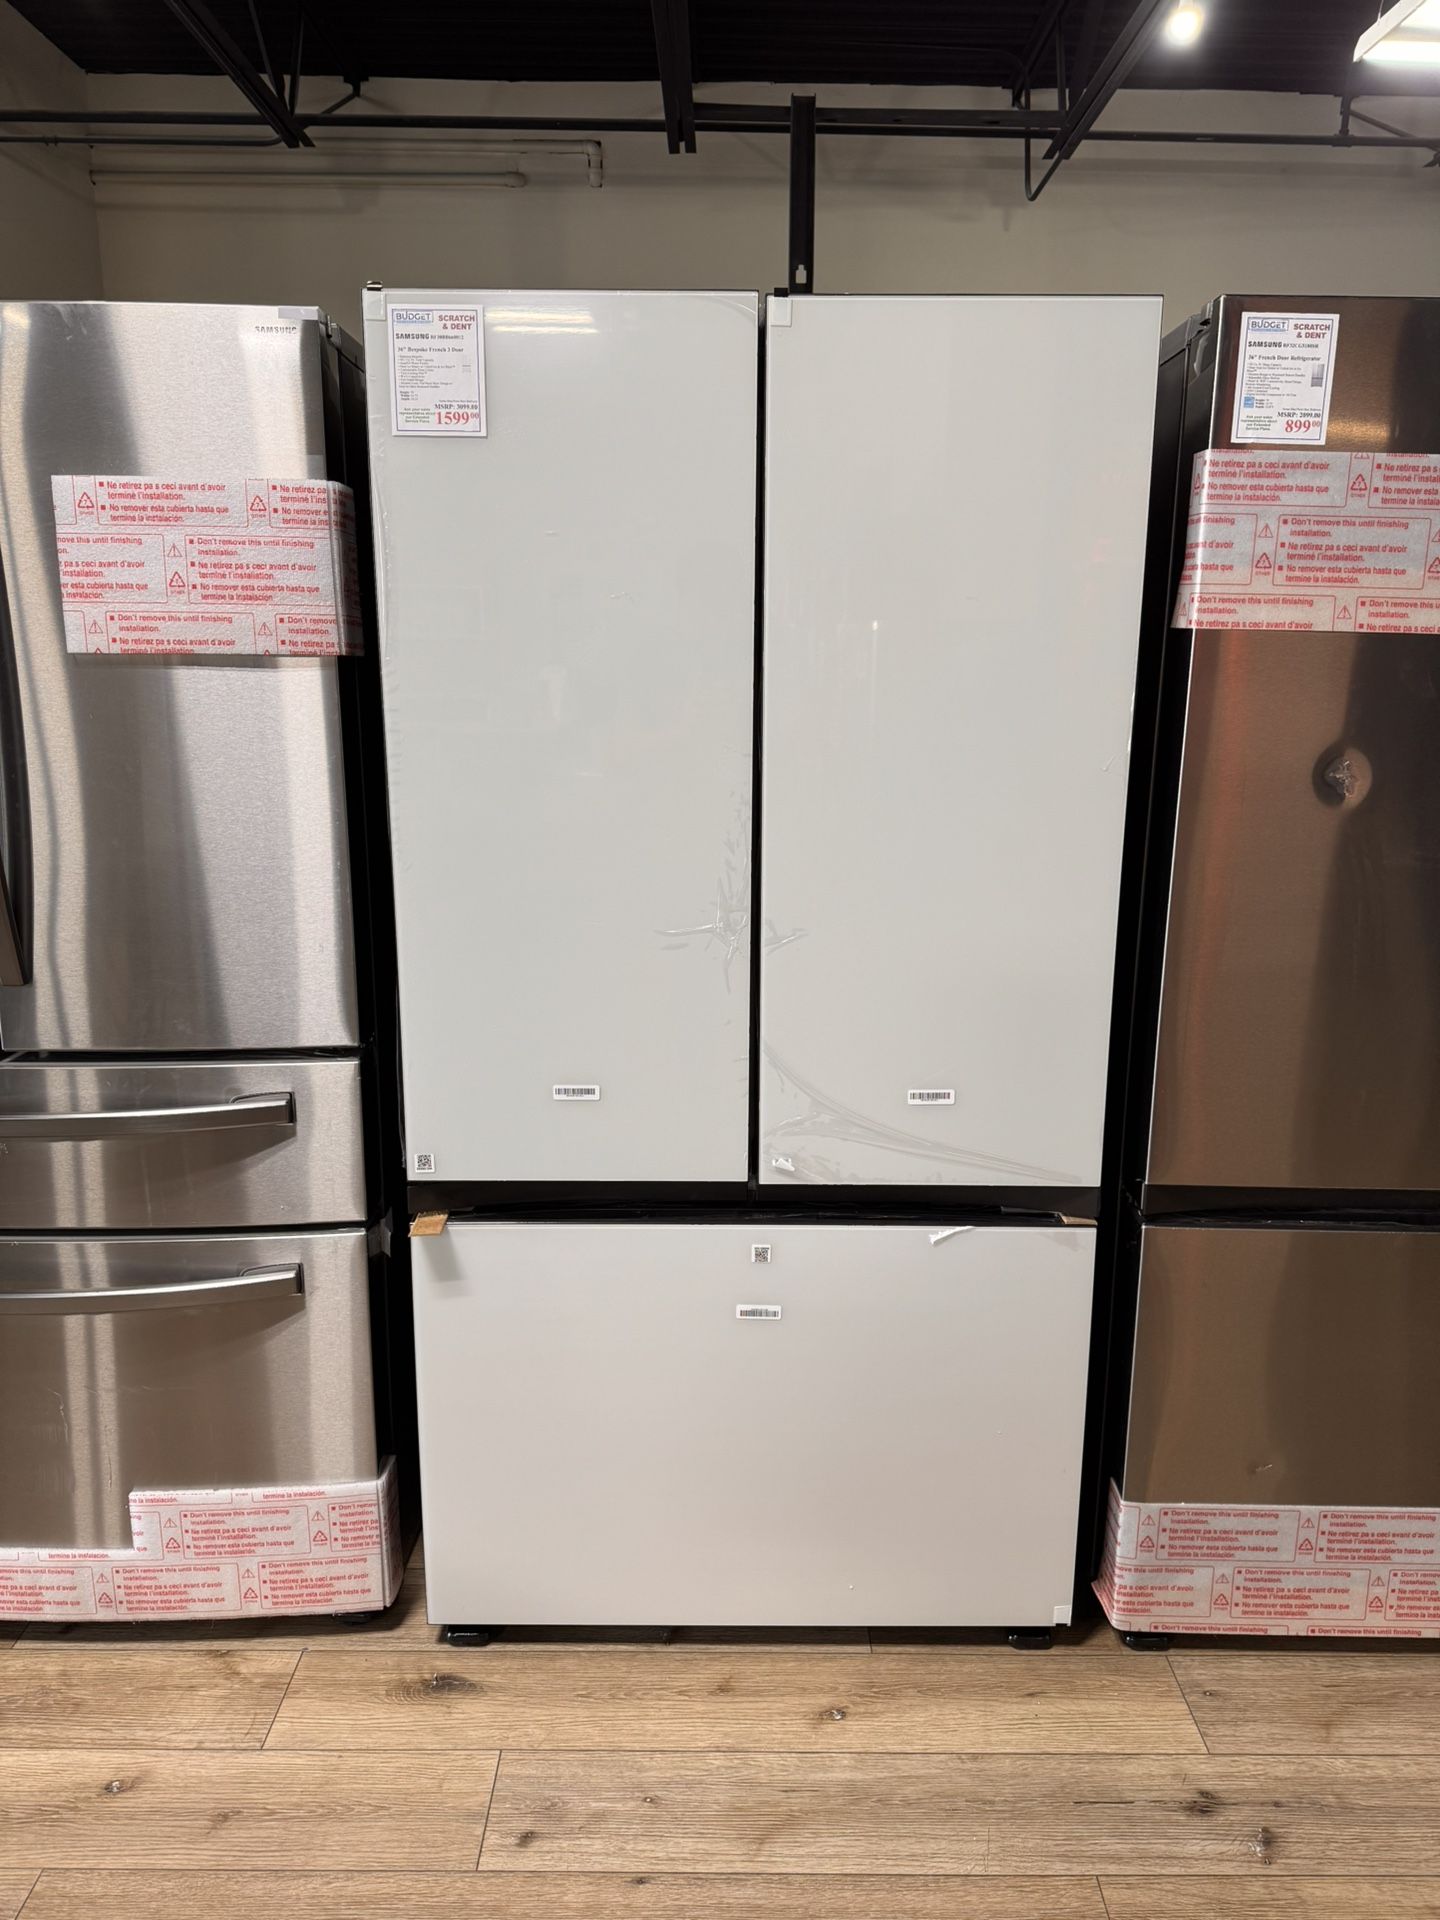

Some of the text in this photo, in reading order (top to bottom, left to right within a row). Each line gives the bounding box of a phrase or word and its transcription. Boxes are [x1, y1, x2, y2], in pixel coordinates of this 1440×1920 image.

[396, 311, 431, 320] BUDGET
[438, 314, 475, 322] SCRATCH
[1251, 320, 1287, 329] BUDGET
[436, 412, 470, 424] 1599
[1285, 419, 1311, 433] 899
[1221, 460, 1244, 468] retirez
[1264, 461, 1279, 469] ceci
[1281, 461, 1302, 469] avant
[119, 482, 142, 490] retirez
[1249, 483, 1264, 491] esta
[1295, 484, 1314, 492] hasta
[1315, 486, 1329, 494] que
[195, 505, 215, 513] hasta
[216, 507, 229, 515] que
[1342, 519, 1356, 527] this
[1376, 520, 1409, 529] finishing
[281, 539, 314, 549] finishing
[1300, 543, 1322, 551] retirez
[1342, 544, 1358, 552] ceci
[210, 562, 232, 570] retirez
[269, 563, 290, 571] avant
[1344, 566, 1371, 574] cubierta
[1393, 568, 1406, 576] que
[256, 584, 284, 592] cubierta
[307, 586, 320, 594] que
[201, 615, 233, 624] finishing
